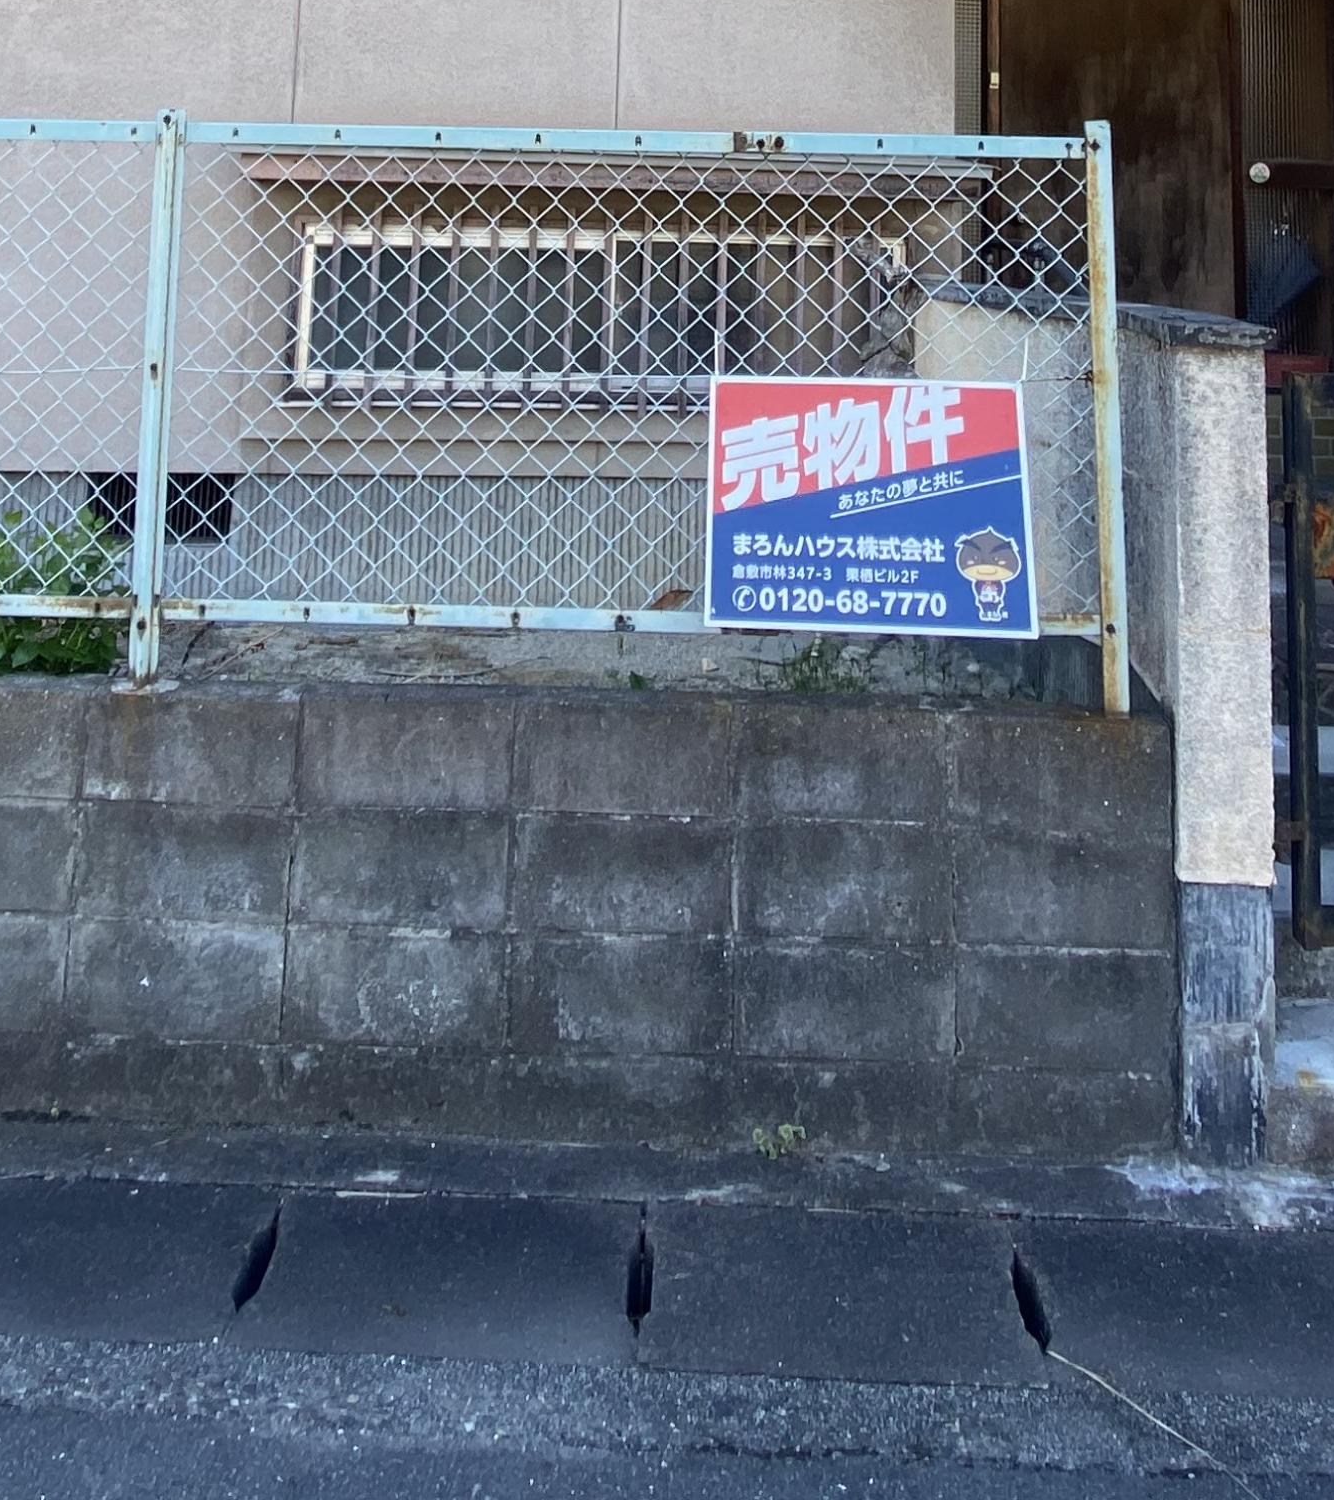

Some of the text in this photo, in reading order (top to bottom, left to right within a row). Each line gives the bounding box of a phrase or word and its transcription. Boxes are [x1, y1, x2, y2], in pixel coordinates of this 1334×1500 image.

[720, 386, 965, 511] 売物件
[838, 470, 964, 510] あなたの夢と共に
[732, 533, 946, 564] まろんハウス株式会社
[759, 587, 947, 618] 0120-68-7770
